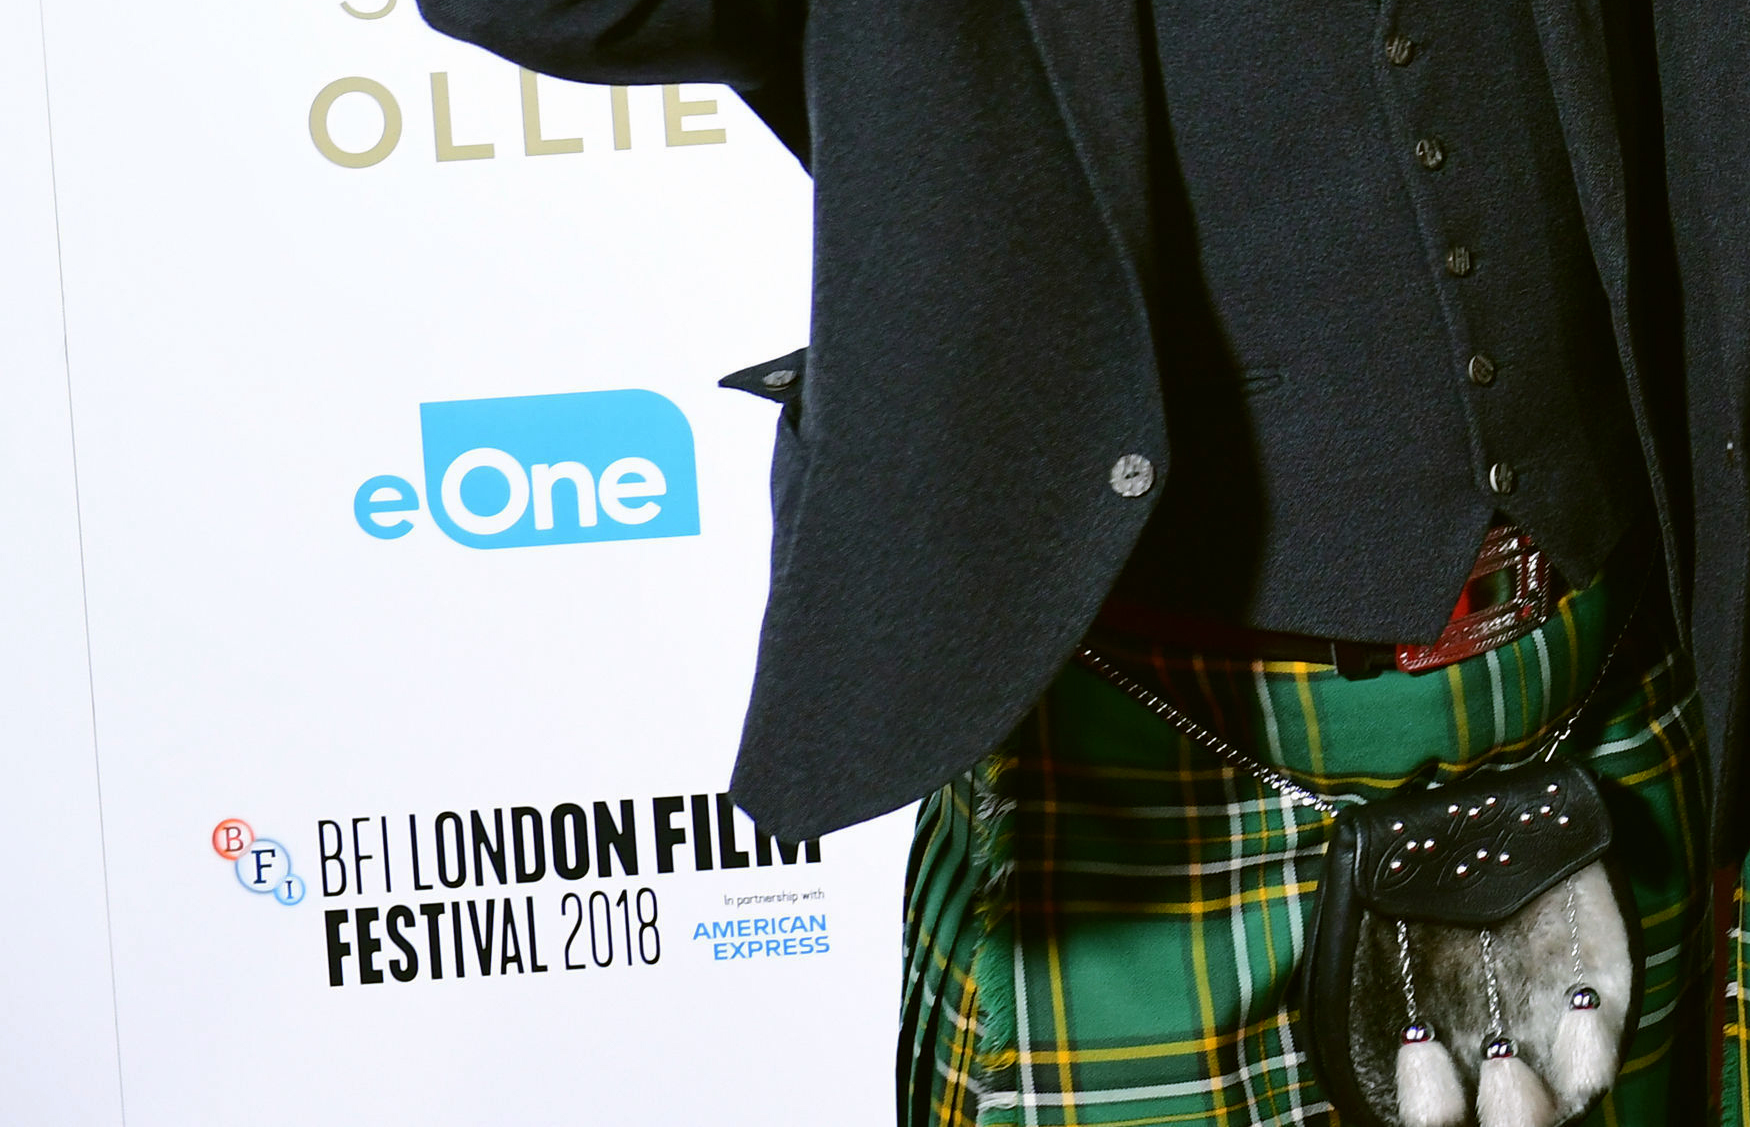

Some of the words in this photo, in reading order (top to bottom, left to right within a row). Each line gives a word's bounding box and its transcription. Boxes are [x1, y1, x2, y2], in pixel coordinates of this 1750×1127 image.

[308, 66, 728, 170] OLLIE
[353, 446, 668, 540] eOne
[317, 815, 392, 898] BFI
[409, 798, 640, 891] LONDON
[323, 895, 548, 988] FESTIVAL
[561, 887, 661, 970] 2018
[692, 913, 828, 941] AMERICAN
[737, 890, 799, 909] partnership
[802, 887, 826, 900] with
[713, 935, 831, 961] EXPRESS
